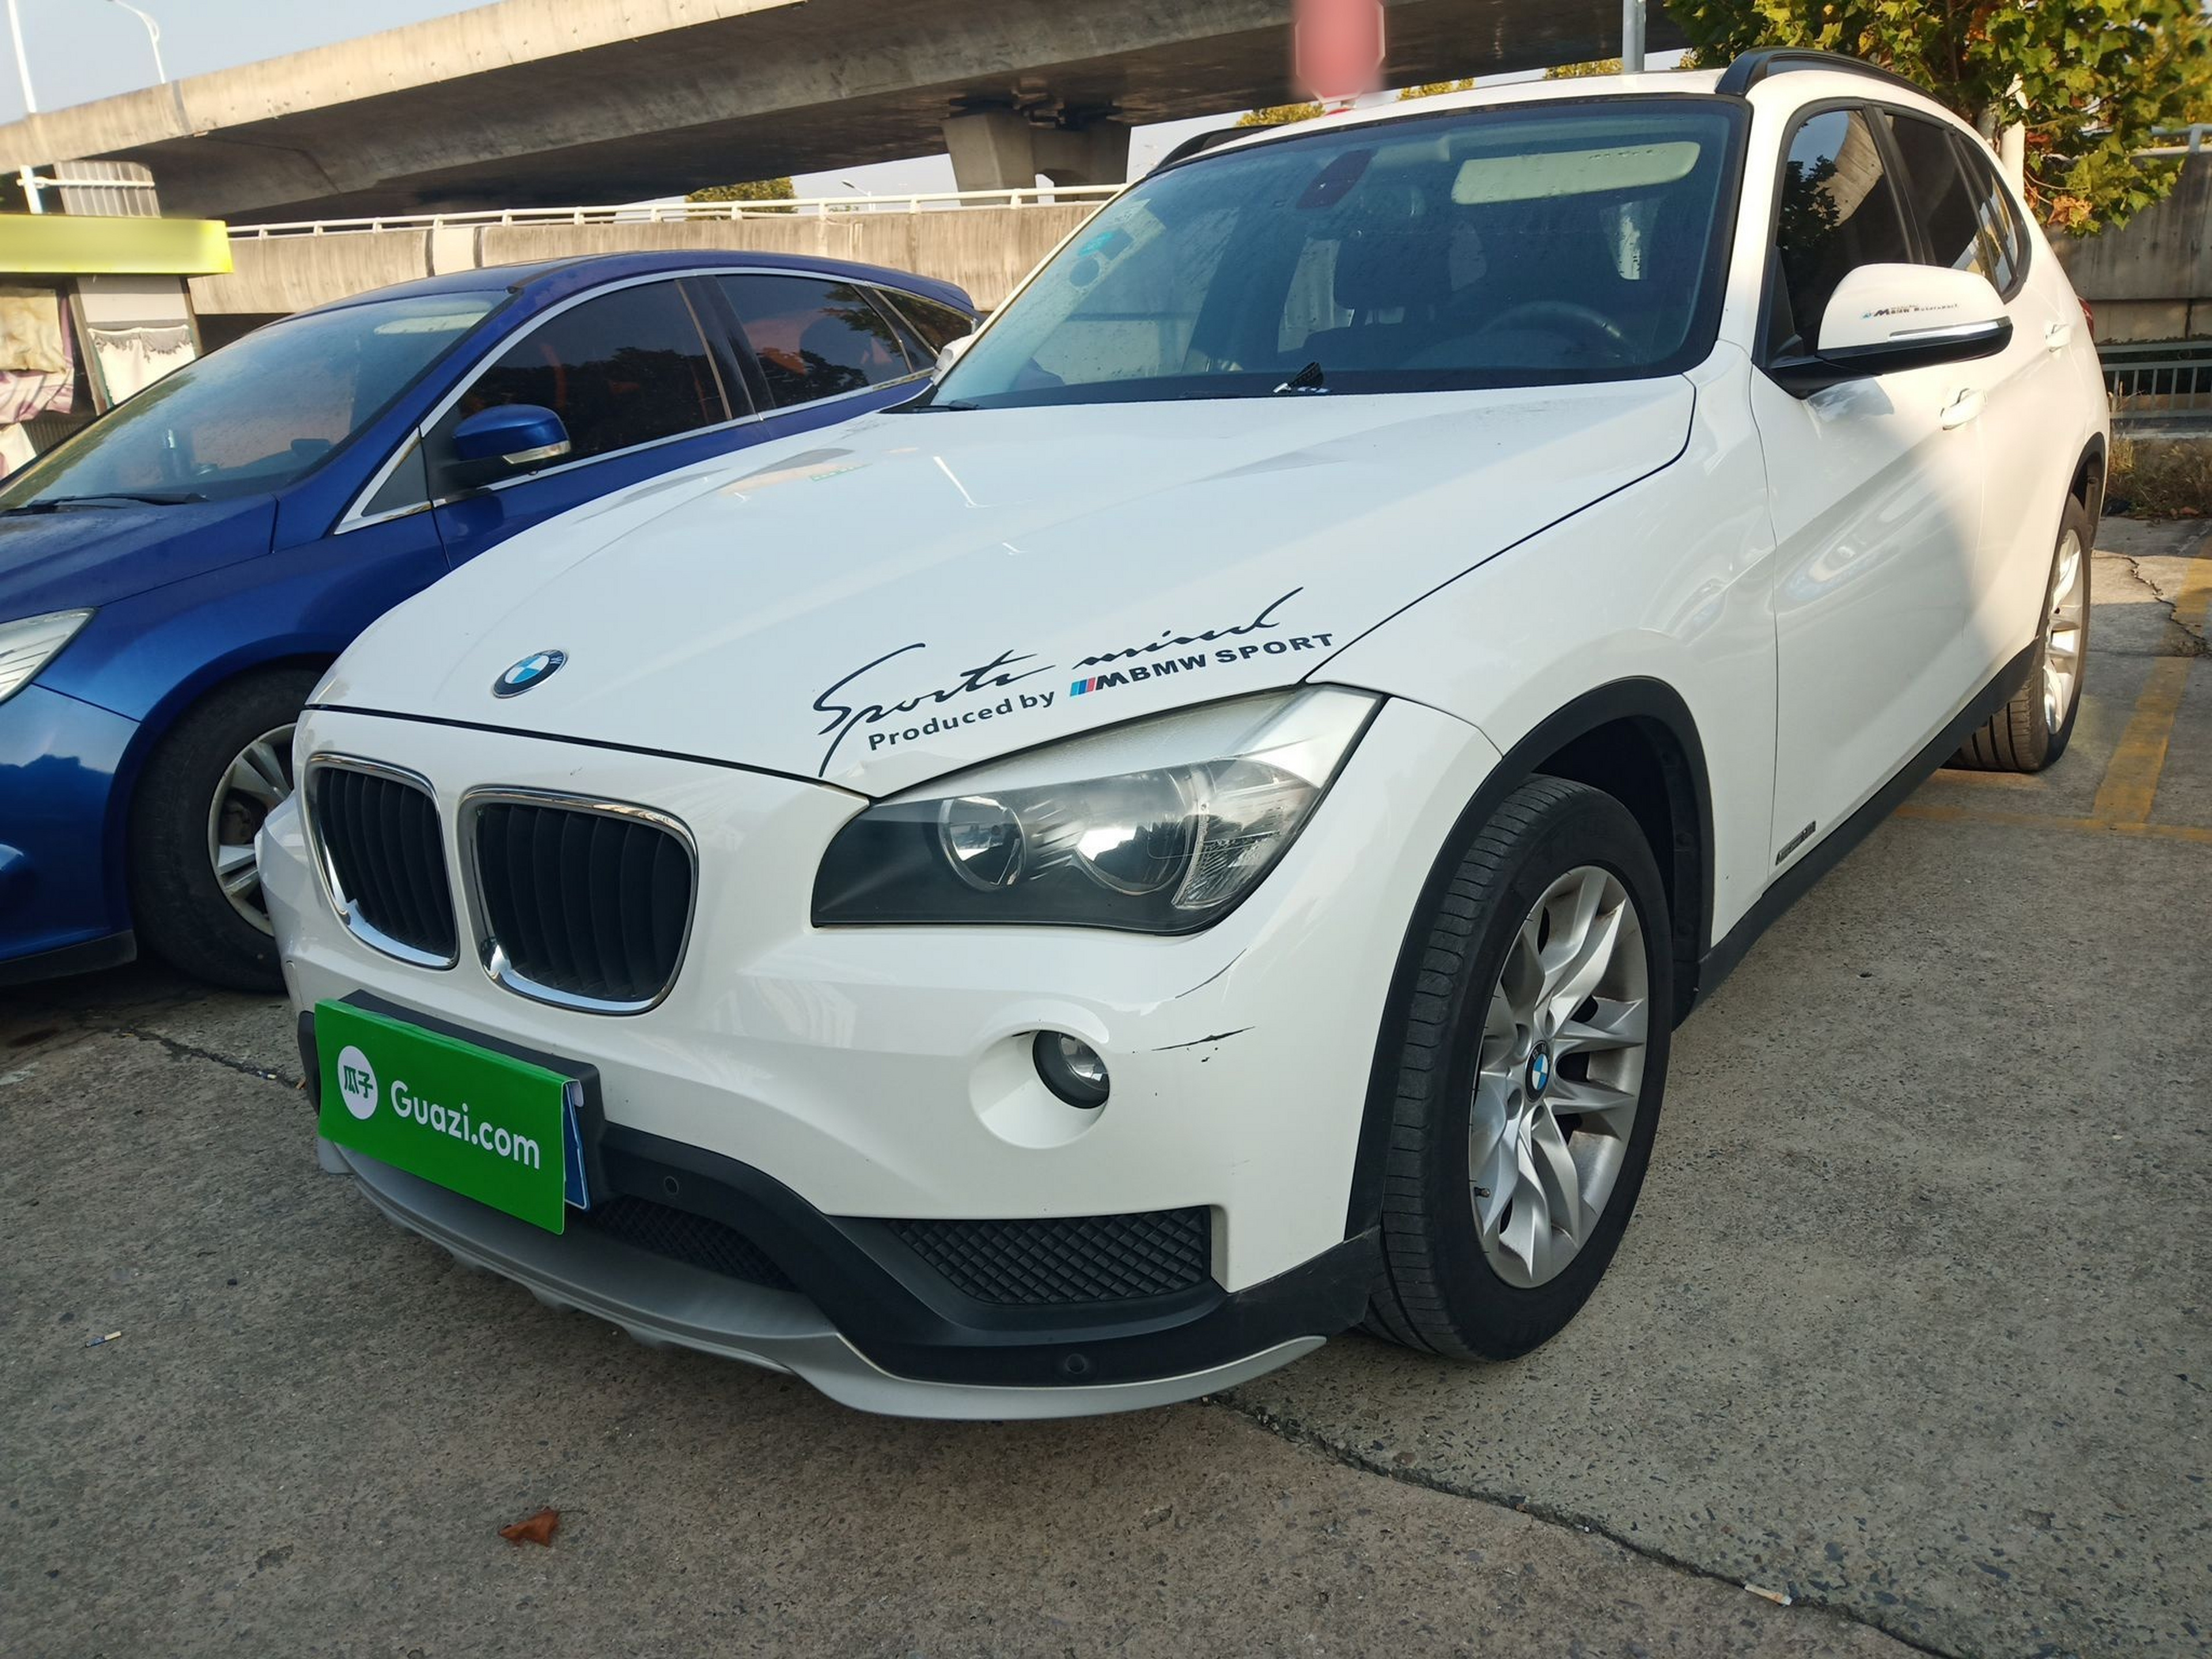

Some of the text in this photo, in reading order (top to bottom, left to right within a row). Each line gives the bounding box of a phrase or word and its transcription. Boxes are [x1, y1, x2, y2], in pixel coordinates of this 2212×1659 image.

[868, 698, 1013, 751] Produced
[1020, 691, 1055, 709] by
[1214, 633, 1333, 663] SPORT
[343, 1065, 373, 1099] 瓜子
[391, 1080, 539, 1169] Guazi.com
